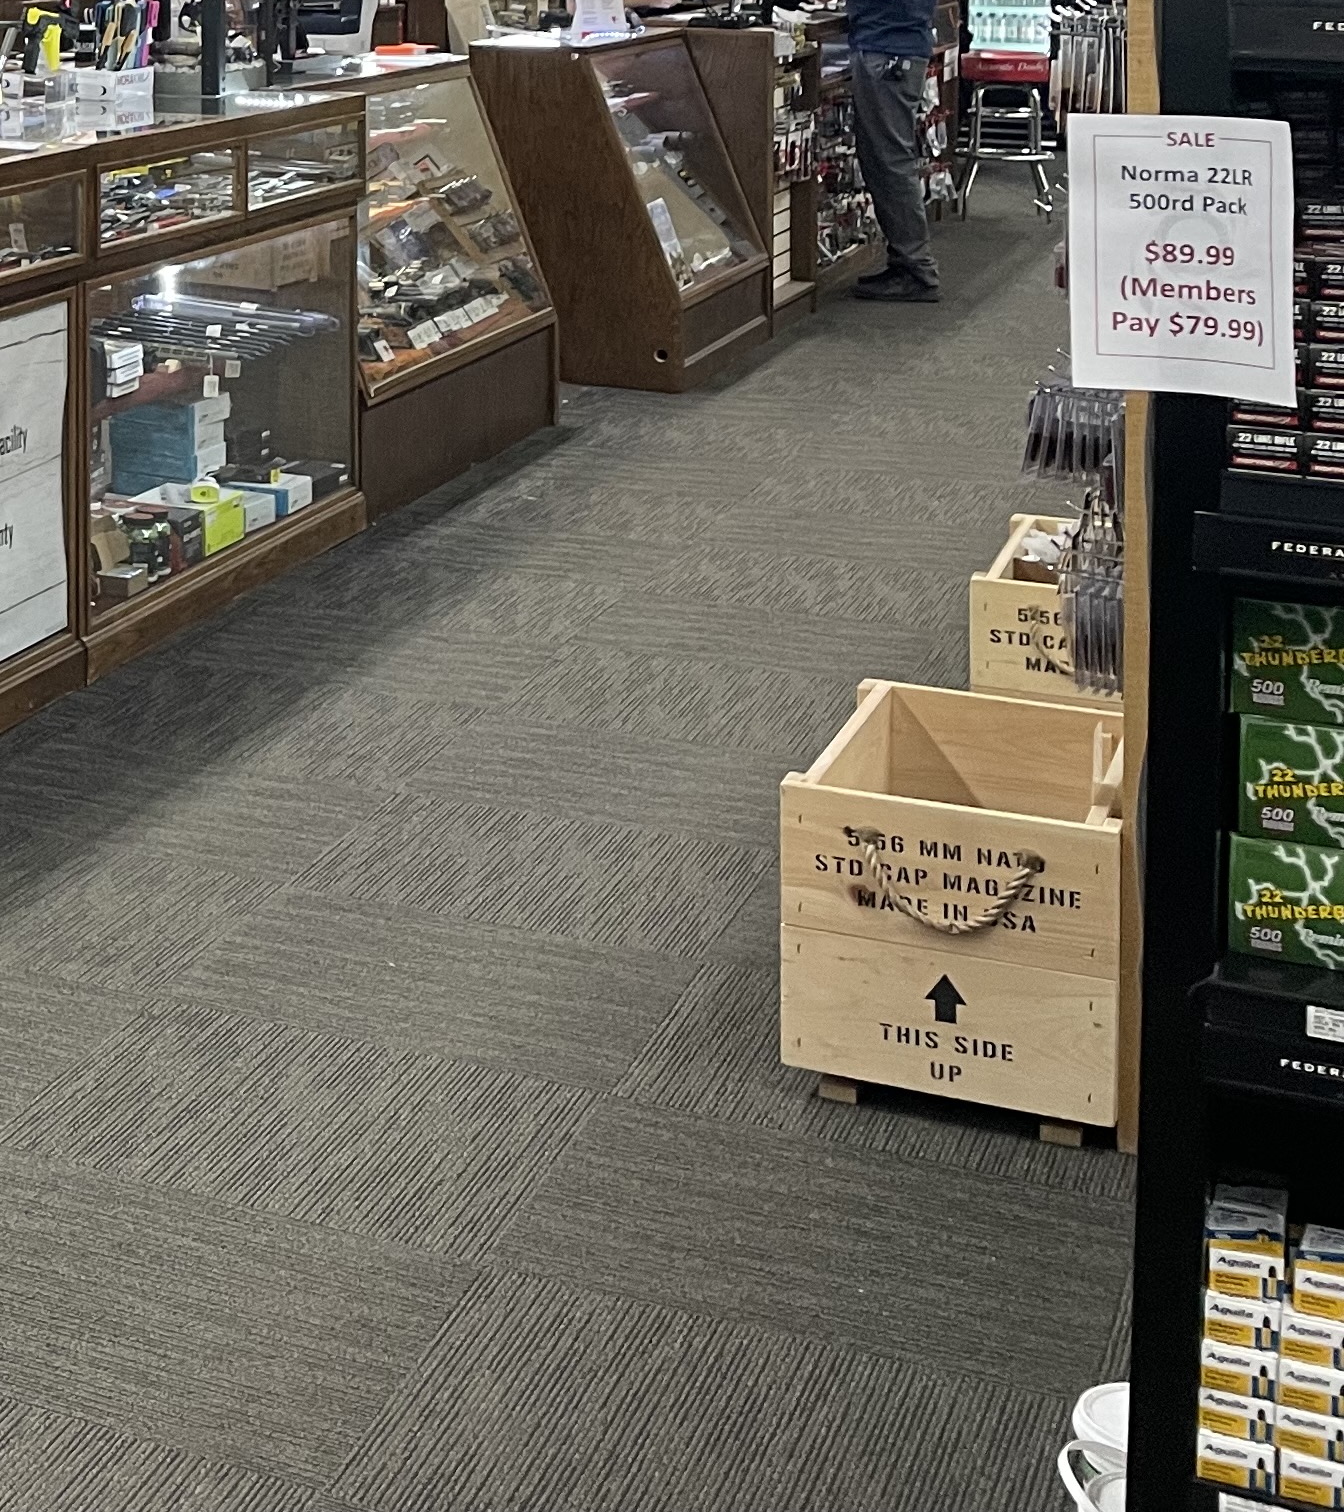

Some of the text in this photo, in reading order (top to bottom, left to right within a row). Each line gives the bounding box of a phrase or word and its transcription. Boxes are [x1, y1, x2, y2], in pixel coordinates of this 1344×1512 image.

[1166, 131, 1216, 148] SALE
[1120, 165, 1253, 187] Norma 22LR
[1128, 193, 1248, 216] 500rd Pack
[1145, 240, 1235, 267] $89.99
[1120, 275, 1257, 306] (Members
[1111, 310, 1265, 348] Pay $79.99)
[1238, 432, 1252, 442] 22
[989, 629, 1031, 647] STD
[1259, 634, 1284, 648] 22
[1251, 678, 1285, 695] 500
[1270, 768, 1297, 782] 22
[1261, 806, 1295, 823] 500
[919, 839, 962, 862] MM
[815, 853, 864, 877] STD
[943, 871, 1082, 910] MAGZINE
[1261, 890, 1284, 903] 22
[943, 902, 968, 922] IN
[984, 908, 1036, 933] SA
[1250, 926, 1283, 943] 500
[879, 1022, 1014, 1063] THIS SIDE
[929, 1061, 963, 1084] UP
[1279, 1058, 1344, 1077] FEDER
